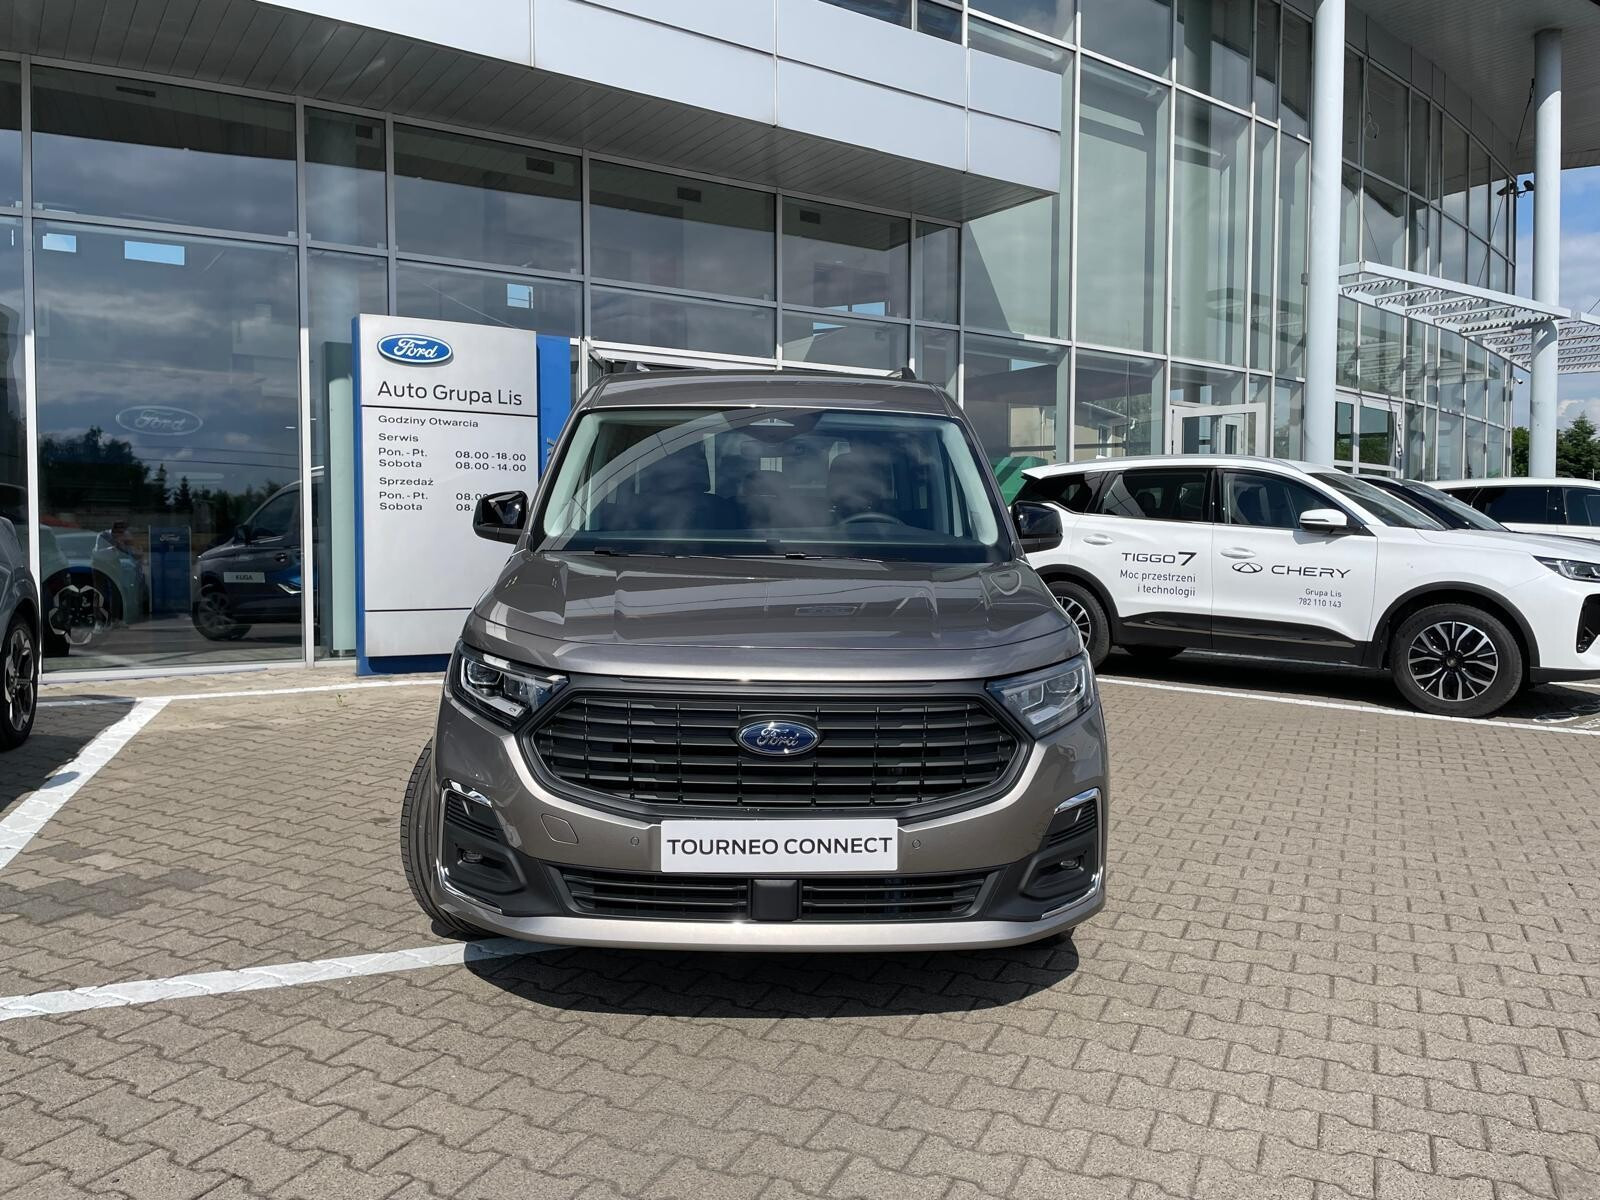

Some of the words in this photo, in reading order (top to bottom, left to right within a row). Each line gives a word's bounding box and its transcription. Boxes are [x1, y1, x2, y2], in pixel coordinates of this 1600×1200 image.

[393, 338, 438, 358] Ford
[378, 381, 427, 399] Auto
[433, 385, 492, 405] Grupa
[498, 389, 522, 406] Lis
[378, 415, 426, 426] Godziny
[429, 417, 479, 428] Otwarcia
[378, 432, 419, 442] Serwis
[378, 459, 422, 468] Sobota
[379, 476, 434, 486] Sprzedaż
[379, 502, 423, 511] Sobota
[1121, 552, 1176, 564] TIGGO
[1178, 551, 1198, 566] 7
[1120, 569, 1139, 579] Moc
[1141, 572, 1196, 583] przestrzeni
[1271, 564, 1352, 579] CHERY
[1143, 585, 1196, 599] technologii
[1305, 588, 1328, 597] Grupa
[1330, 590, 1342, 598] Lis
[1298, 597, 1312, 606] 782
[1314, 598, 1327, 607] 110
[1329, 600, 1342, 608] 143
[757, 728, 799, 746] Ford
[667, 838, 779, 855] TOURNEO
[783, 836, 893, 855] CONNECT
